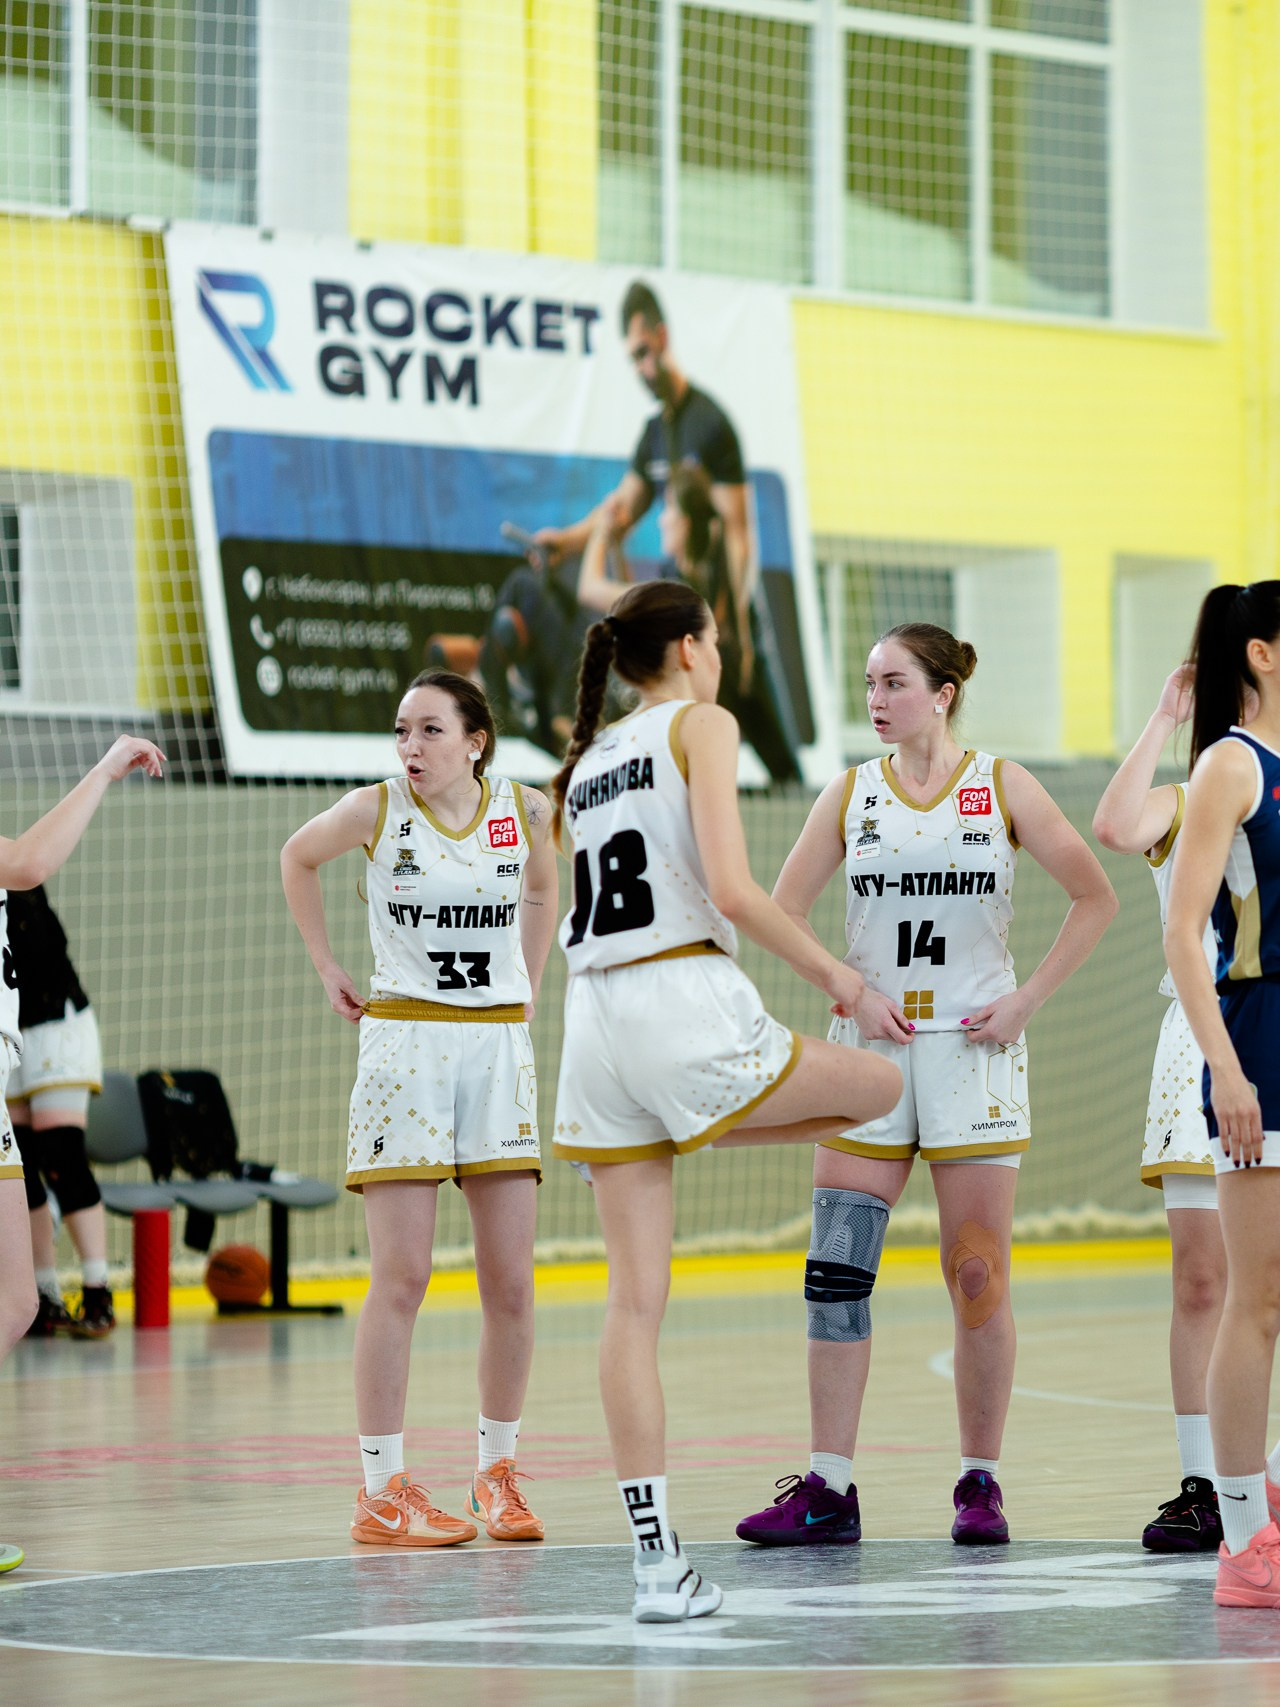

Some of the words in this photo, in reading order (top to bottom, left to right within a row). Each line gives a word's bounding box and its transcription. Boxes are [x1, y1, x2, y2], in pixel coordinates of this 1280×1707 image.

[312, 278, 603, 356] ROCKET
[318, 342, 481, 407] GYM
[961, 790, 988, 801] FON
[962, 801, 989, 811] BET
[492, 831, 515, 844] BET
[567, 829, 655, 948] 18
[851, 872, 996, 897] ЧГУ-АТЛАНТА
[897, 920, 946, 967] 14
[427, 952, 490, 990] 33
[971, 1120, 1017, 1131] ХИМПРОМ
